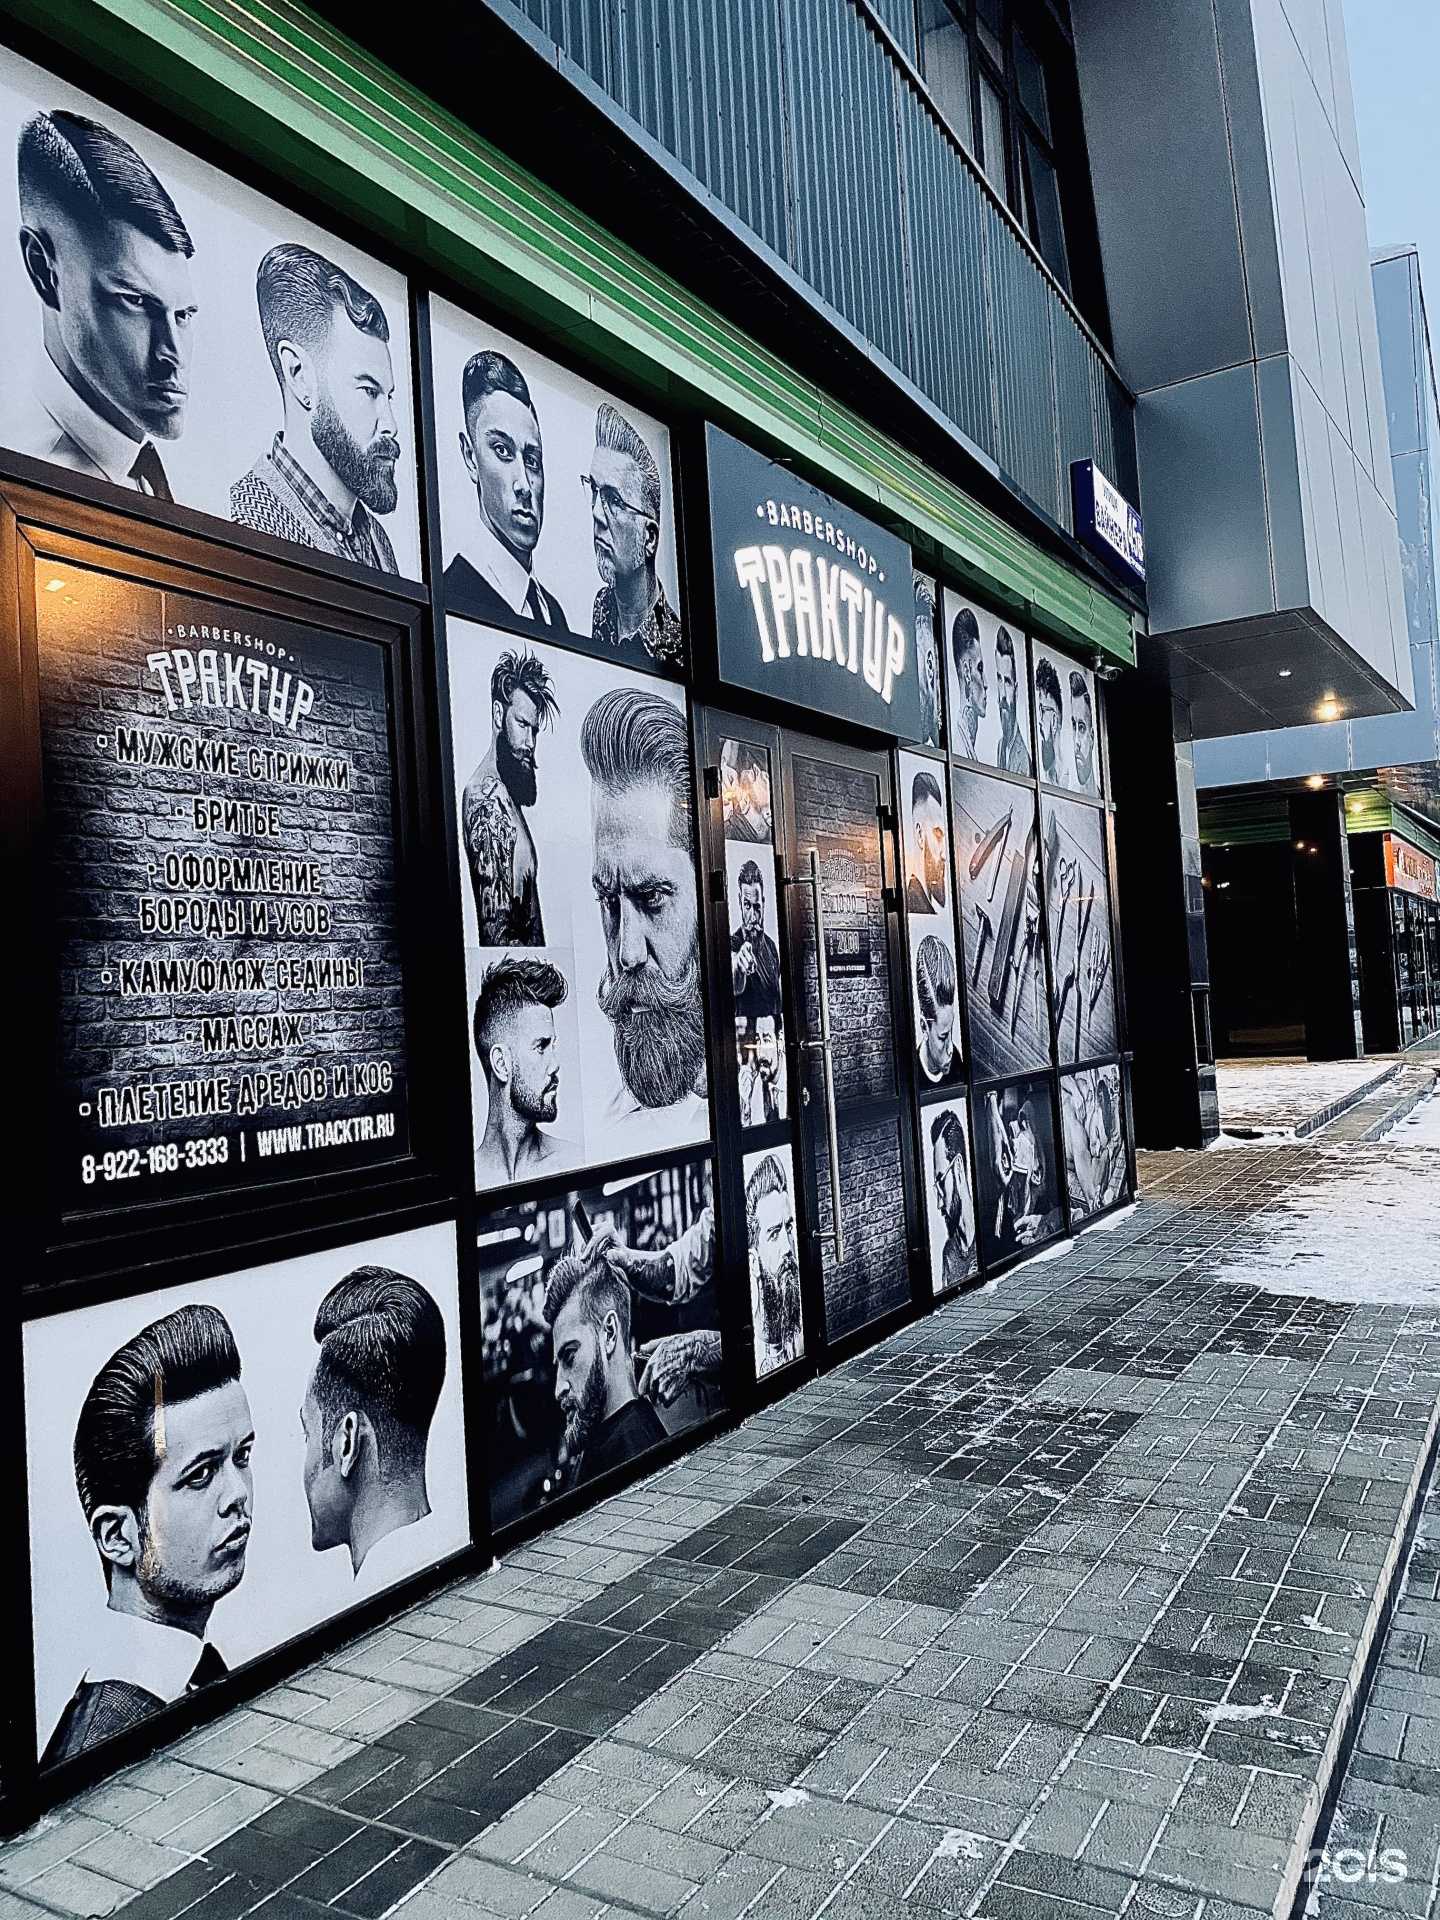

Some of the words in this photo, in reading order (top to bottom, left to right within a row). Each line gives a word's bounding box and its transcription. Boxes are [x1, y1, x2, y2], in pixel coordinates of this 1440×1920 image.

[767, 500, 877, 575] BARBERSHOP
[177, 624, 287, 659] BARBERSHOP
[116, 727, 240, 777] МУЖСКИЕ
[247, 747, 351, 791] СТРИЖКИ
[192, 798, 281, 837] БРИТЬЕ
[164, 853, 322, 894] ОФОРМЛЕНИЕ
[139, 897, 245, 939] БОРОДЫ
[252, 900, 268, 934] И
[275, 901, 331, 935] УСОВ
[119, 958, 267, 995] КАМУФЛЯЖ
[275, 958, 364, 994] СЕДИНЫ
[201, 1016, 304, 1054] МАССАЖ
[98, 1078, 231, 1127] ПЛЕТЕНИЕ
[237, 1067, 327, 1115] ДРЕДОВ
[333, 1064, 349, 1097] И
[353, 1061, 393, 1094] КОС
[82, 1137, 229, 1184] 8-922-168-3333
[256, 1113, 395, 1157] WWW.TRACKTIR.RU
